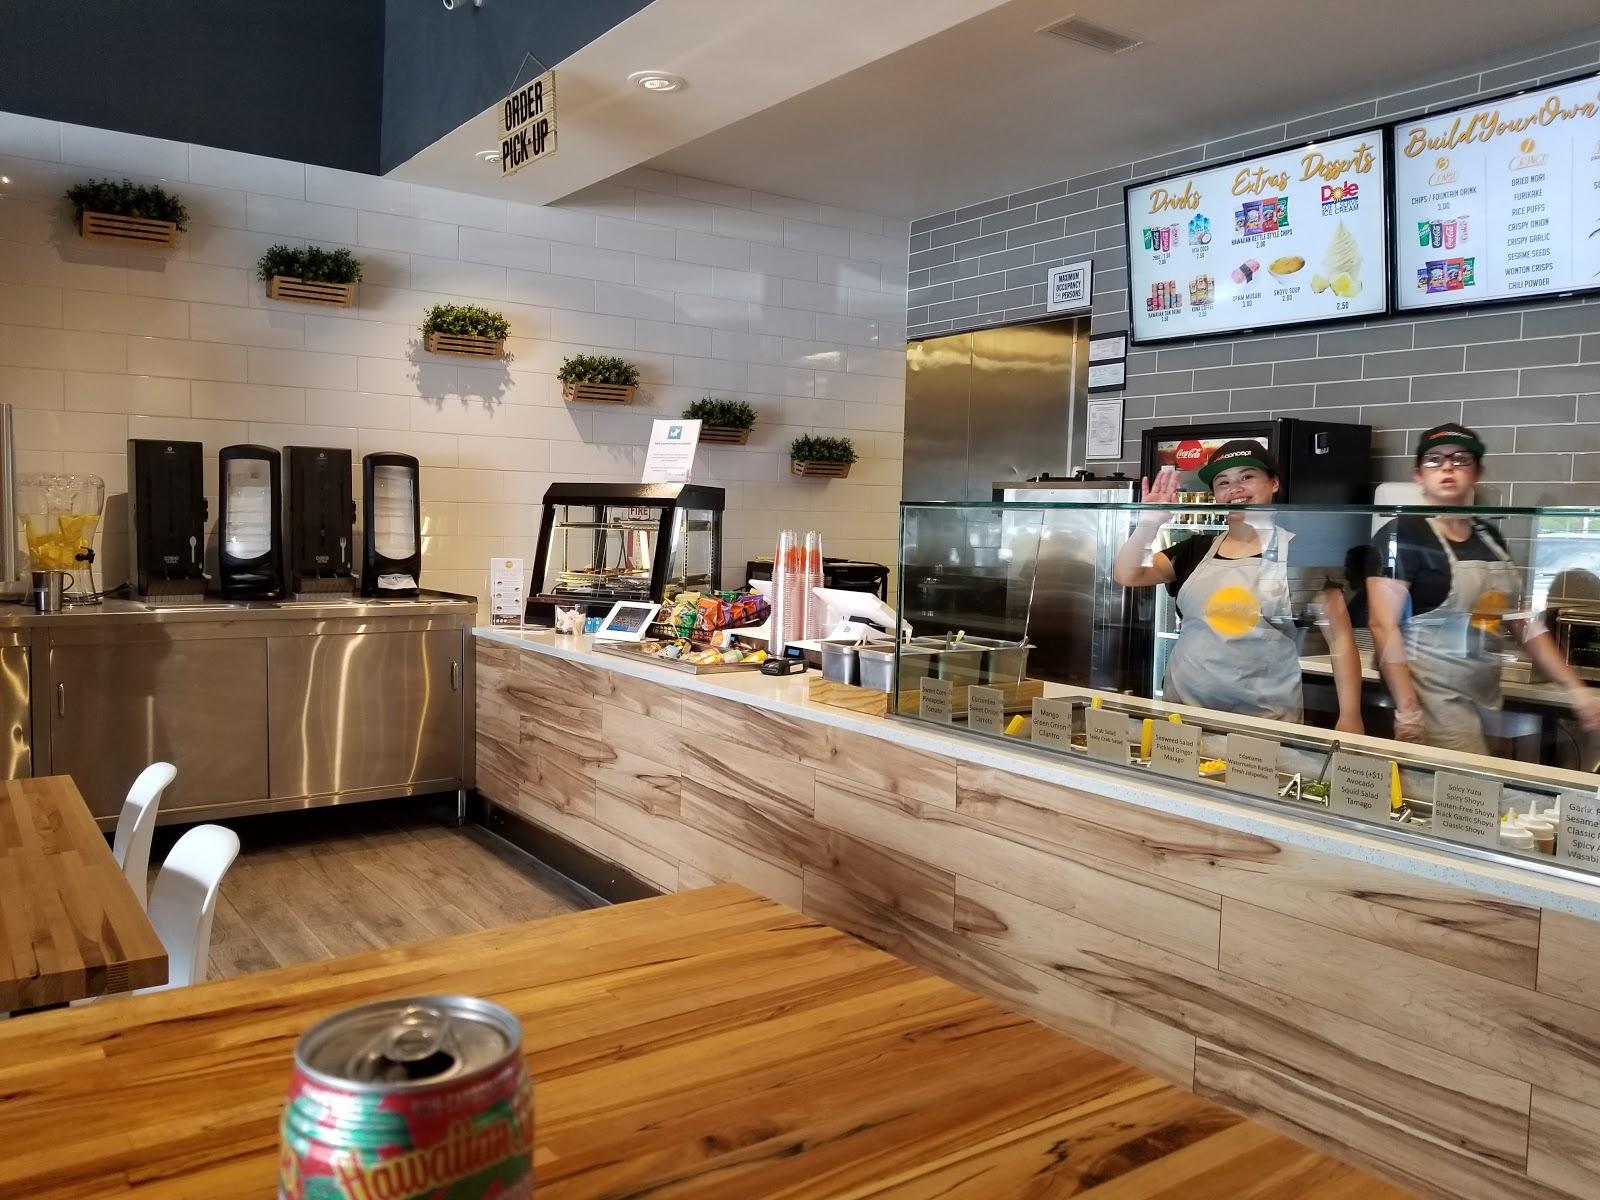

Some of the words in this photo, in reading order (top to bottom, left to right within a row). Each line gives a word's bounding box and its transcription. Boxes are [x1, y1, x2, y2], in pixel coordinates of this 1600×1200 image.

[505, 80, 543, 131] ORDER
[1404, 111, 1478, 157] Build
[1479, 110, 1537, 142] Your
[1538, 96, 1598, 125] Own
[503, 118, 549, 172] PICK-UP
[1148, 180, 1202, 214] Drinks
[1232, 166, 1290, 196] Extras
[1299, 143, 1376, 182] Desserts
[1511, 175, 1529, 186] DRIED
[1530, 173, 1546, 183] NORI
[1321, 181, 1359, 202] Dole
[1411, 195, 1428, 205] CHIPS
[1432, 190, 1459, 201] FOUNTAIN
[1460, 186, 1477, 196] DRINK
[1514, 189, 1543, 201] FURIKAKE
[1322, 208, 1333, 217] ICE
[1335, 204, 1359, 214] CREAM
[1511, 207, 1526, 216] RICE
[1526, 203, 1545, 214] PUFFS
[1508, 221, 1529, 232] CRISPY
[1530, 218, 1549, 229] ONION
[1252, 234, 1266, 242] KETTLE
[1267, 231, 1279, 240] STYLE
[1281, 229, 1293, 238] CHIPS
[1507, 236, 1528, 247] CRISPY
[1529, 233, 1551, 243] GARLIC
[1507, 250, 1530, 261] SESAME
[1531, 248, 1551, 258] SEEDS
[1505, 265, 1530, 276] WONTON
[1531, 262, 1553, 273] CRISPS
[1058, 271, 1079, 282] MAXIMUM
[1056, 280, 1080, 292] OCCUPANCY
[1289, 286, 1300, 294] SOUP
[1508, 280, 1524, 290] CHILI
[1524, 278, 1550, 288] POWDER
[1062, 288, 1081, 299] PERSONS
[1337, 302, 1349, 310] 2.50
[630, 506, 649, 516] FIRE
[921, 686, 935, 696] Sweet
[926, 705, 943, 714] Tomato
[969, 705, 984, 714] Sweet
[984, 708, 999, 717] Onion
[1040, 708, 1060, 720] Mango
[976, 715, 993, 725] Carrots
[1033, 719, 1049, 728] Green
[1050, 721, 1067, 731] Onion
[1038, 729, 1060, 740] Cilantro
[1155, 733, 1178, 746] Seaweed
[1179, 738, 1194, 748] Salad
[1156, 743, 1175, 754] Pickled
[1175, 746, 1193, 757] Ginger
[1163, 753, 1185, 764] Masago
[1238, 752, 1263, 763] Edamame
[1227, 758, 1257, 770] Watermelon
[1257, 764, 1274, 773] Radish
[1231, 766, 1245, 776] Fresh
[1337, 764, 1365, 777] Add-ons
[1366, 769, 1384, 782] (+$1)
[1346, 776, 1375, 789] Avocado
[1341, 786, 1360, 798] Squid
[1360, 789, 1379, 800] Salad
[1448, 783, 1466, 796] Spicy
[1466, 785, 1482, 797] Yuzu
[1346, 797, 1373, 809] Tamago
[1446, 793, 1464, 805] Spicy
[1464, 796, 1485, 807] Shoyu
[1435, 800, 1474, 816] Gluten-Free
[1474, 807, 1495, 819] Shoyu
[1569, 803, 1595, 814] Garlic
[1435, 808, 1452, 819] Black
[1453, 812, 1473, 824] Garlic
[1474, 816, 1495, 828] Shoyu
[1566, 814, 1599, 828] Sesame
[1442, 820, 1462, 832] Classic
[1462, 823, 1485, 836] Shoyu
[1567, 826, 1596, 839] Classic
[1572, 839, 1595, 852] Spicy
[1567, 849, 1599, 864] Wasabi
